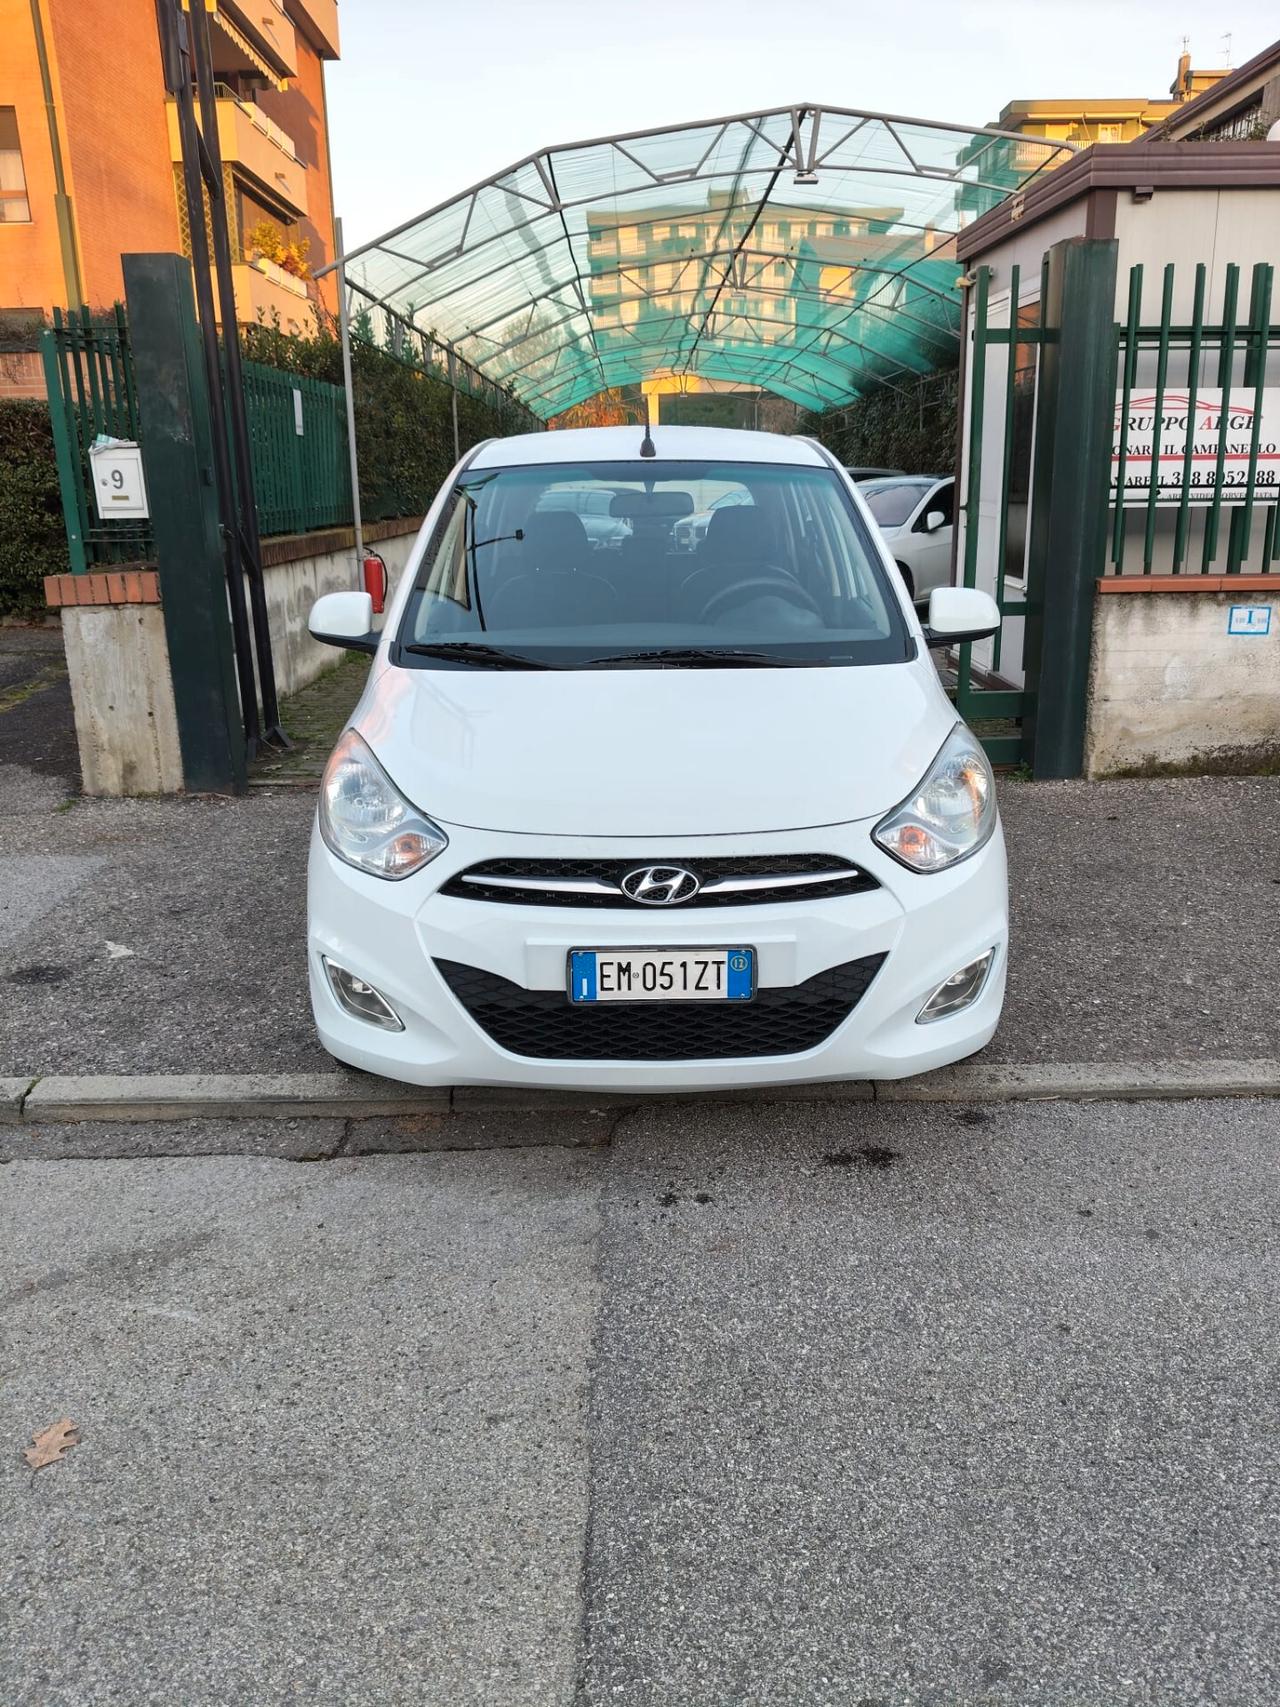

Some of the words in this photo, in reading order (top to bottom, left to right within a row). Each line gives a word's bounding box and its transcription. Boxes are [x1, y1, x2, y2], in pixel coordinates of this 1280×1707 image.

[1164, 444, 1178, 455] IL
[1181, 443, 1277, 454] CAMANELO
[111, 469, 124, 490] 9
[600, 961, 632, 991] EM
[642, 960, 726, 991] 051ZT
[733, 958, 744, 969] 12
